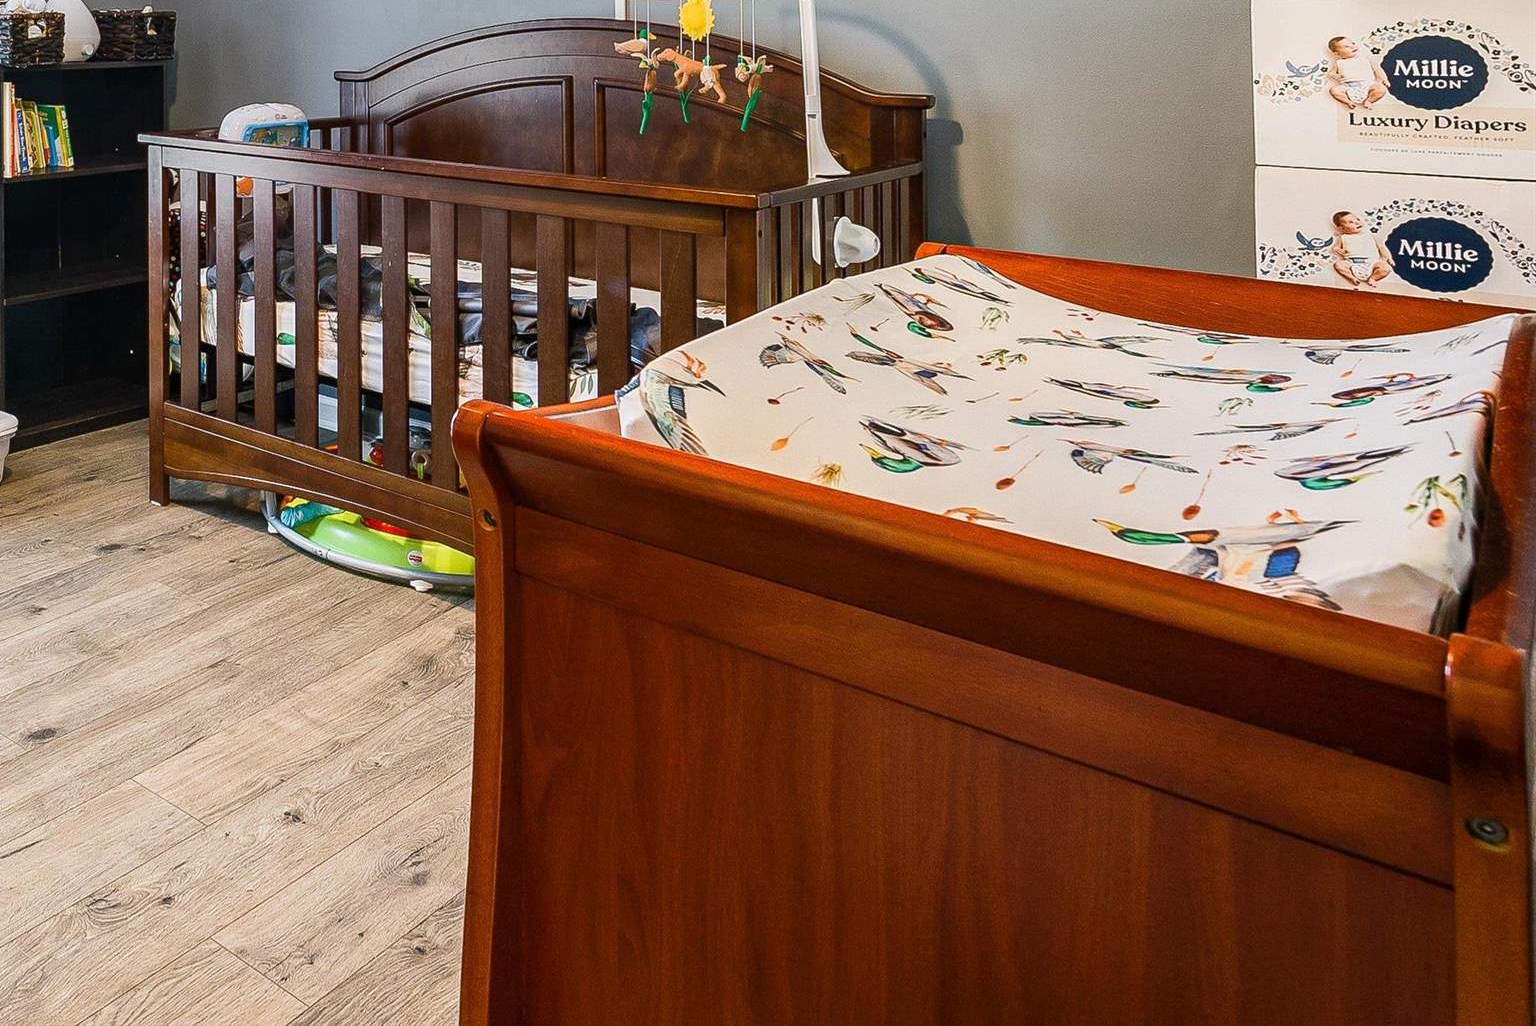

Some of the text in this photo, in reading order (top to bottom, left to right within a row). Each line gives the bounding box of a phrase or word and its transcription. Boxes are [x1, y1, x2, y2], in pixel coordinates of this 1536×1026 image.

[1393, 58, 1475, 78] Millie
[1406, 78, 1462, 89] MOON
[1348, 112, 1528, 134] Luxury Diapers
[1397, 238, 1479, 262] Millie
[1410, 259, 1466, 274] MOON
